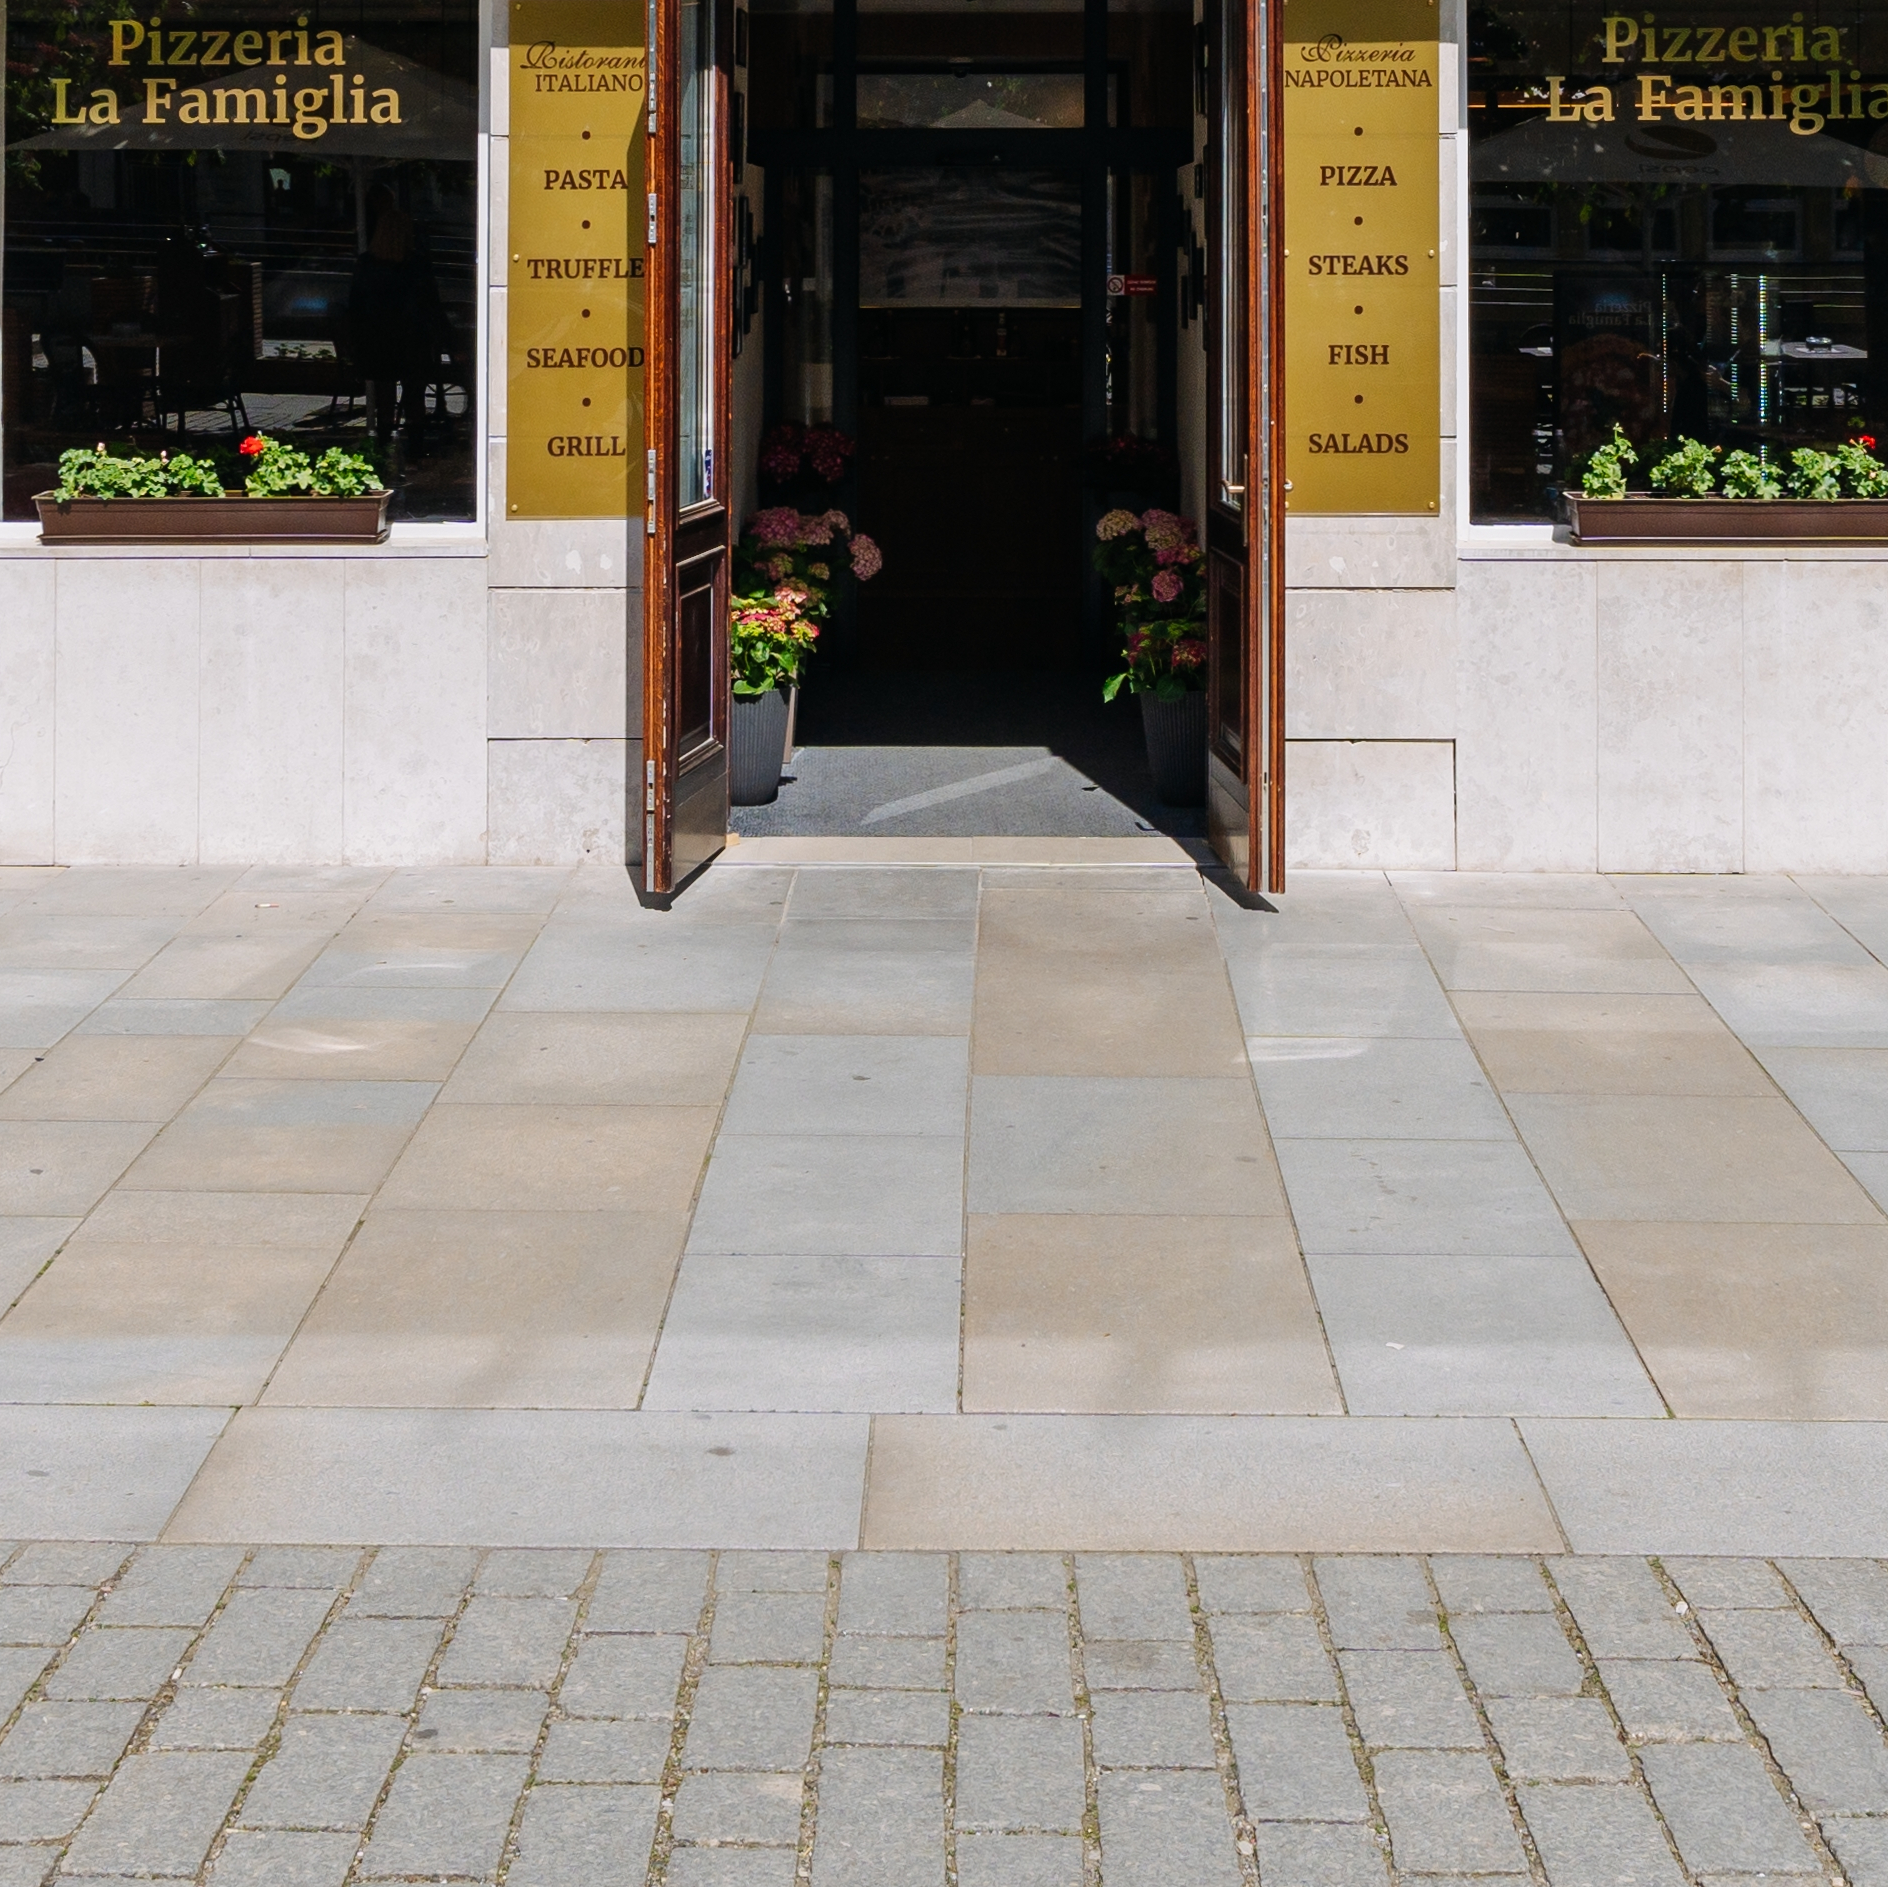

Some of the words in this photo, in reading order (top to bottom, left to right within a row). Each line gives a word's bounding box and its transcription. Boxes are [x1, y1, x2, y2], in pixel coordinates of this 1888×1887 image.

[108, 16, 346, 67] Pizzeria
[1300, 33, 1417, 63] Pizzeria
[1602, 12, 1843, 63] Pizzeria
[535, 73, 644, 92] ITALIANO
[1284, 69, 1433, 88] NAPOLETANA
[51, 78, 120, 124] La
[142, 73, 403, 140] Famiglia
[1545, 75, 1615, 122] La
[543, 169, 629, 191] PASTA
[1319, 165, 1398, 187] PIZZA
[526, 258, 644, 280] TRUFFLE
[1308, 254, 1409, 276] STEAKS
[526, 347, 644, 369] SEAFOOD
[1328, 344, 1390, 366] FISH
[546, 436, 627, 457] GRILL
[1308, 433, 1410, 454] SALADS
